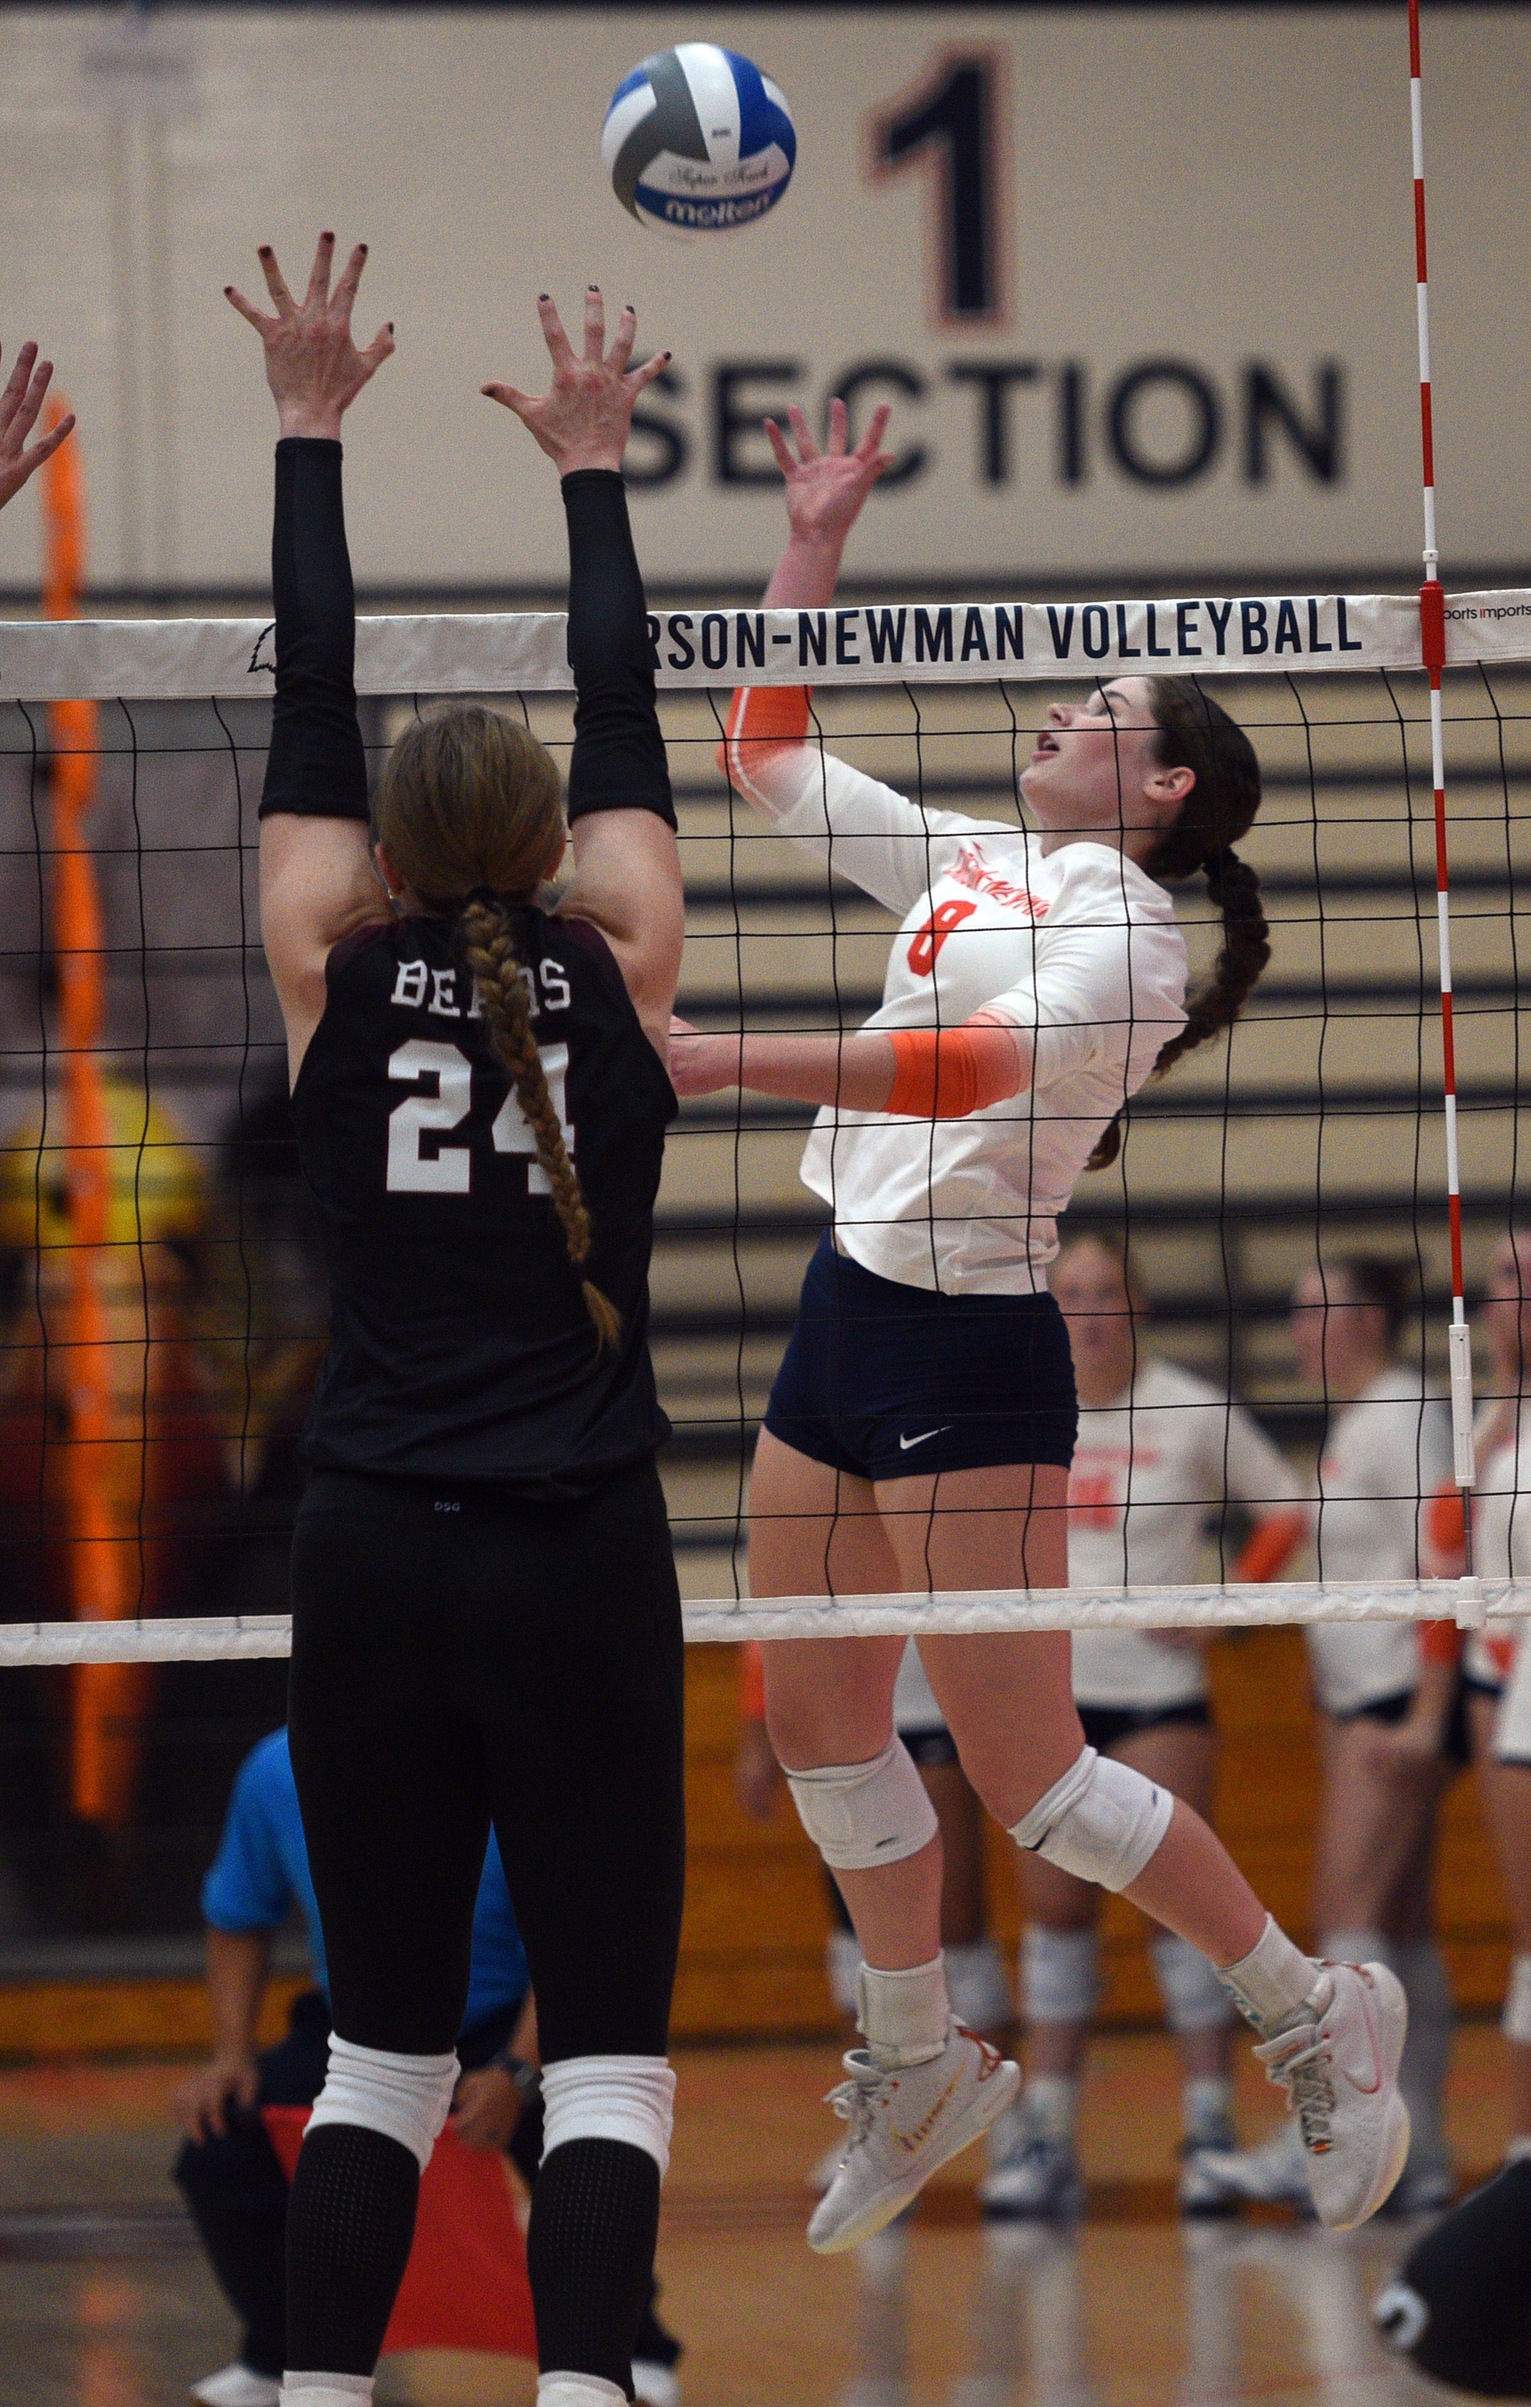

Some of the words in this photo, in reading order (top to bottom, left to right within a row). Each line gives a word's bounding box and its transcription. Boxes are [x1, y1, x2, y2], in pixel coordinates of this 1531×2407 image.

[664, 192, 770, 227] molten
[862, 42, 1013, 336] 1
[626, 355, 1346, 492] SECTION
[646, 605, 1025, 670] RSON-NEWMAN
[1047, 597, 1363, 660] VOLLEYBALL
[1443, 607, 1478, 620] ports
[906, 899, 978, 977] 8
[390, 958, 571, 1019] BES
[386, 1038, 576, 1195] 24
